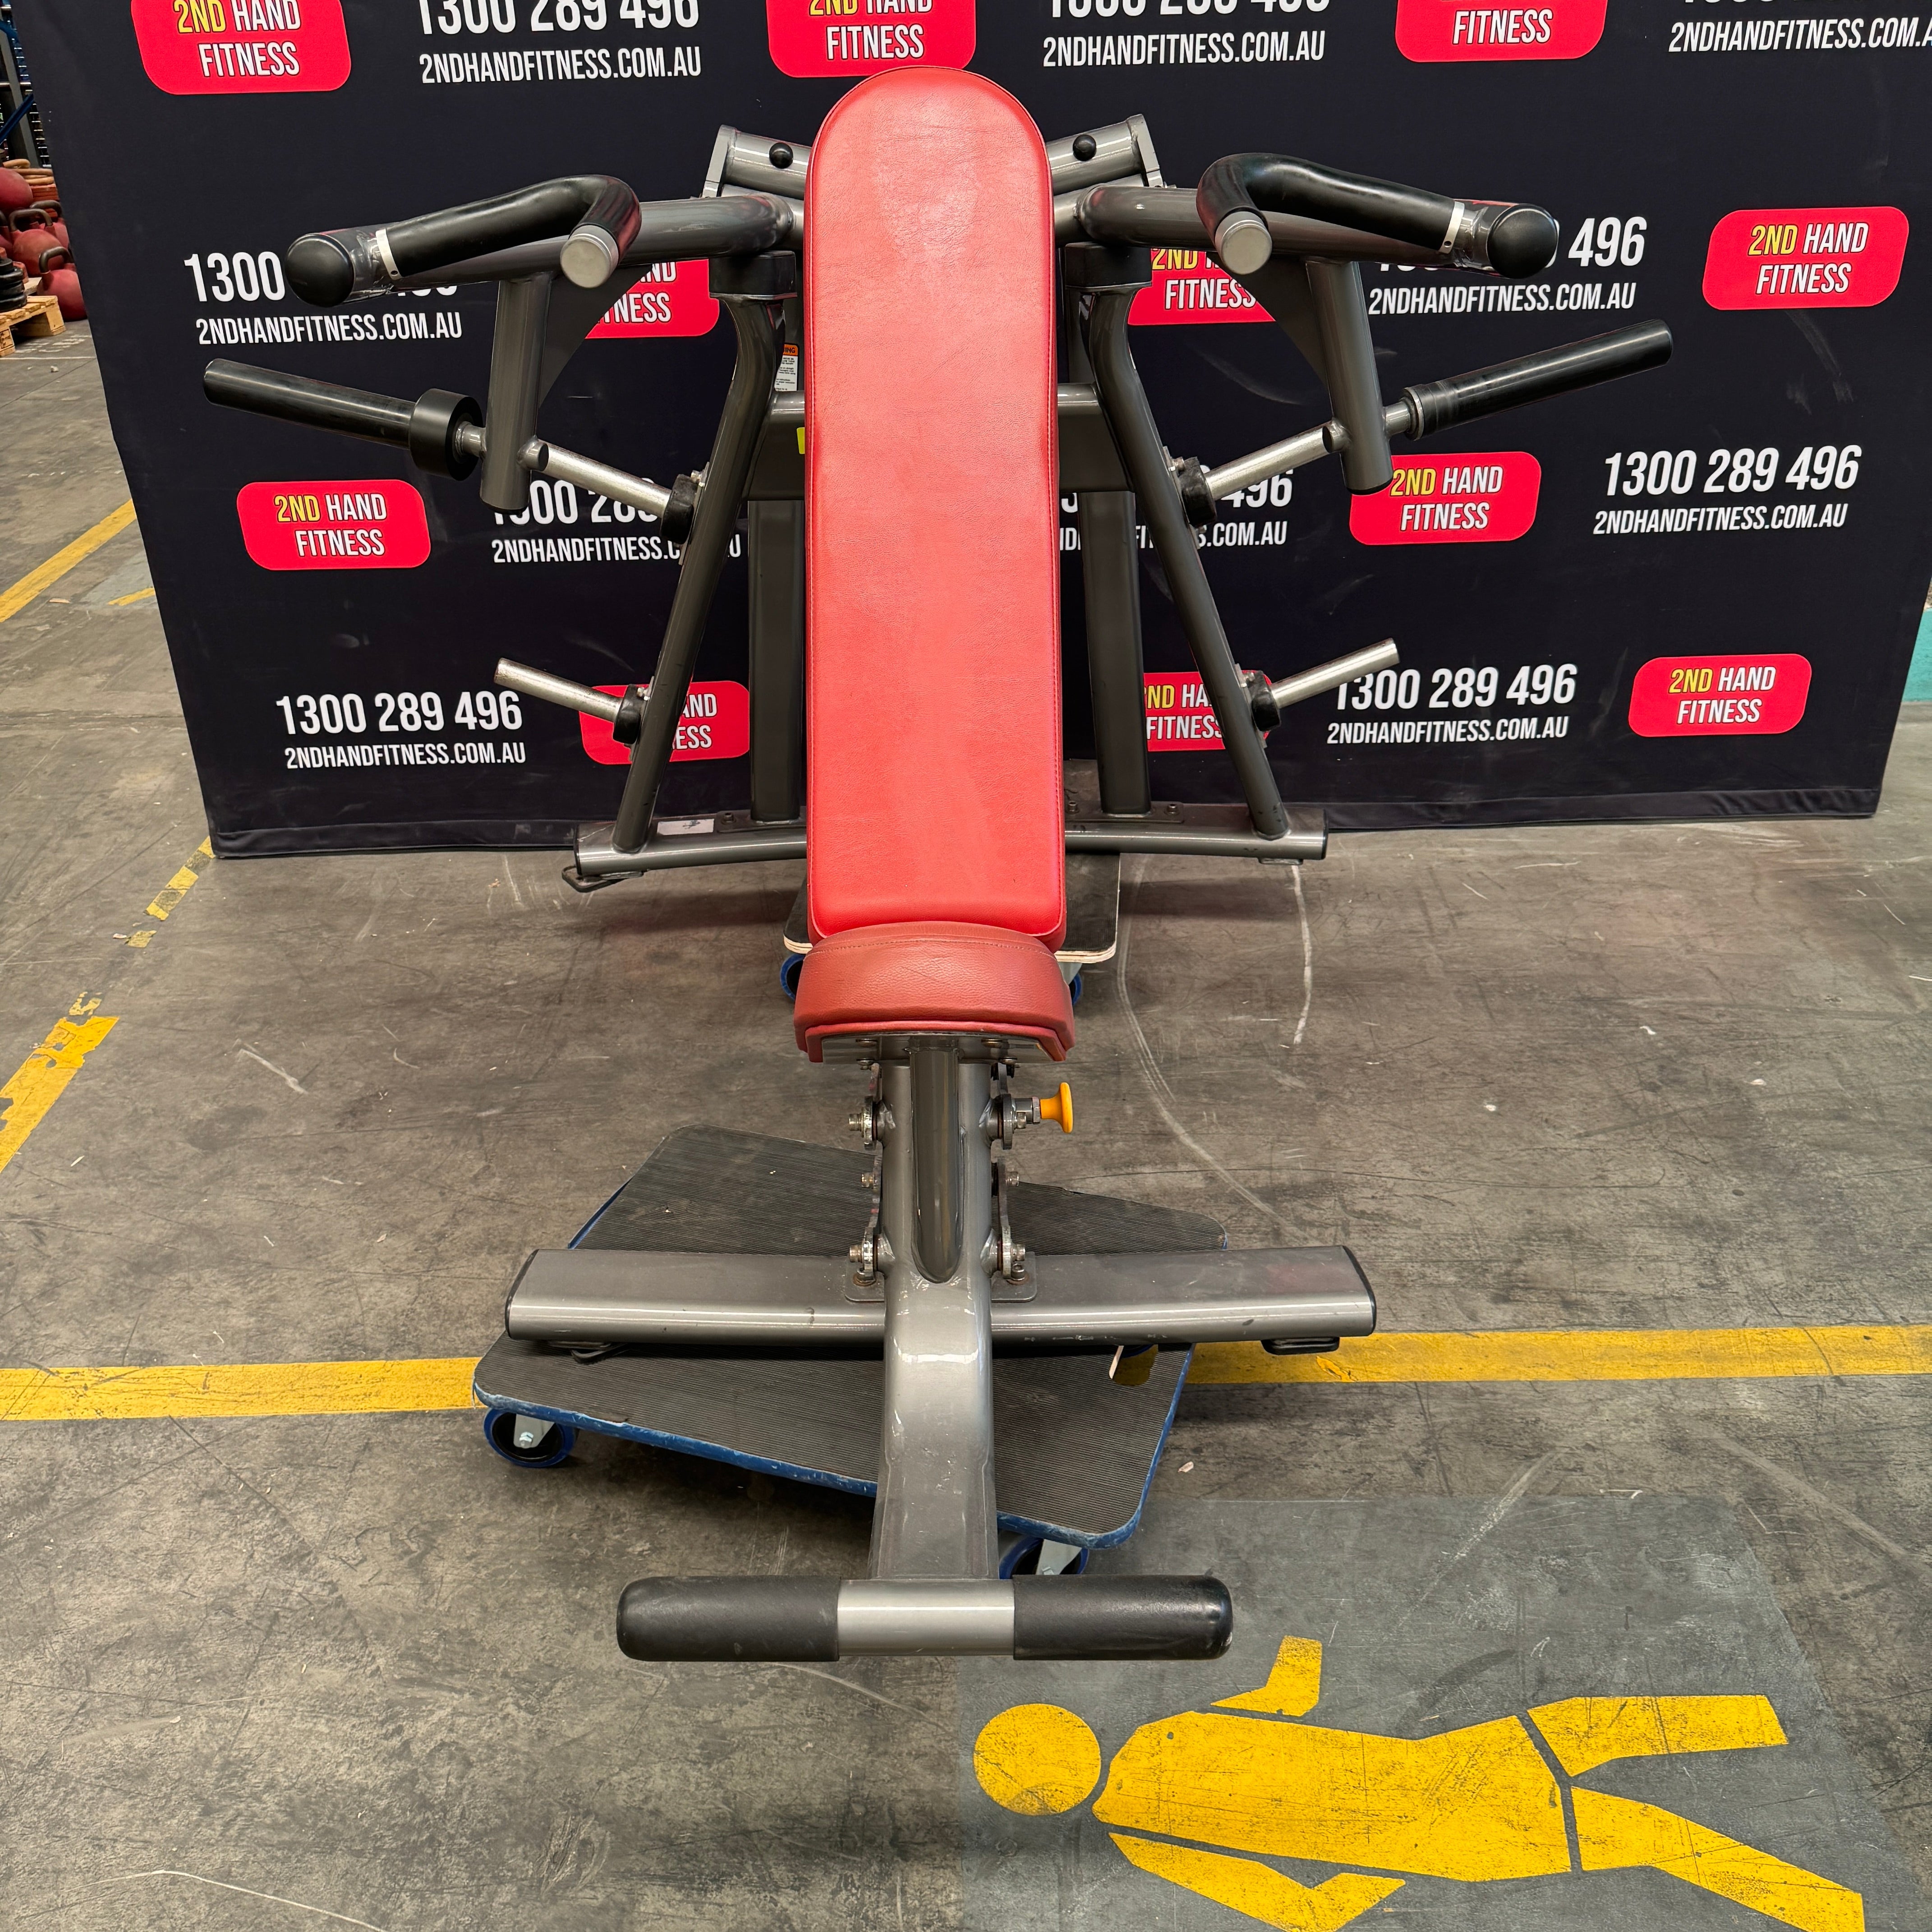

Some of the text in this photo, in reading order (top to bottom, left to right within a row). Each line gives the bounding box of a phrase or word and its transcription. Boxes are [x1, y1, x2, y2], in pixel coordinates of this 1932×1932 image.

[174, 0, 300, 33] 2ND HAND
[1453, 9, 1552, 44] FITNESS
[827, 24, 924, 59] FITNESS
[1043, 30, 1325, 67] 2NDHANDFITNESS.COM.AU
[198, 41, 299, 77] FITNESS
[419, 46, 701, 83] 2NDHANDFITNESS.COM.AU
[1568, 216, 1647, 267] 496
[1748, 223, 1868, 255] 2ND HAND
[640, 262, 676, 282] ND
[1152, 248, 1198, 270] 2ND
[184, 251, 285, 302] 1300
[1756, 263, 1851, 294] FITNESS
[598, 292, 671, 322] NESS
[1165, 279, 1256, 309] FITNESS
[1368, 282, 1637, 315] 2NDHANDFITNESS.COM.AU
[196, 312, 462, 345] 2NDHANDFITNESS.COM.AU
[1390, 466, 1503, 496] 2ND HAND
[1605, 445, 1862, 496] 1300 289 496
[275, 494, 386, 522] 2ND HAND
[494, 480, 578, 524] 00
[1401, 502, 1490, 530] FITNESS
[1593, 503, 1849, 534] 2NDHANDFITNESS.COM.AU
[295, 529, 385, 556] FITNESS
[1337, 663, 1577, 710] 1300 289 496
[1669, 667, 1776, 693] 2ND HAND
[683, 694, 717, 718] ND
[1144, 684, 1208, 708] ND HA
[1677, 699, 1762, 724] FITNESS
[276, 690, 522, 735] 1300 289 496
[1327, 716, 1569, 744] 2NDHANDFITNESS.COM.AU
[285, 742, 526, 769] 2NDHANDFITNESS.COM.AU
